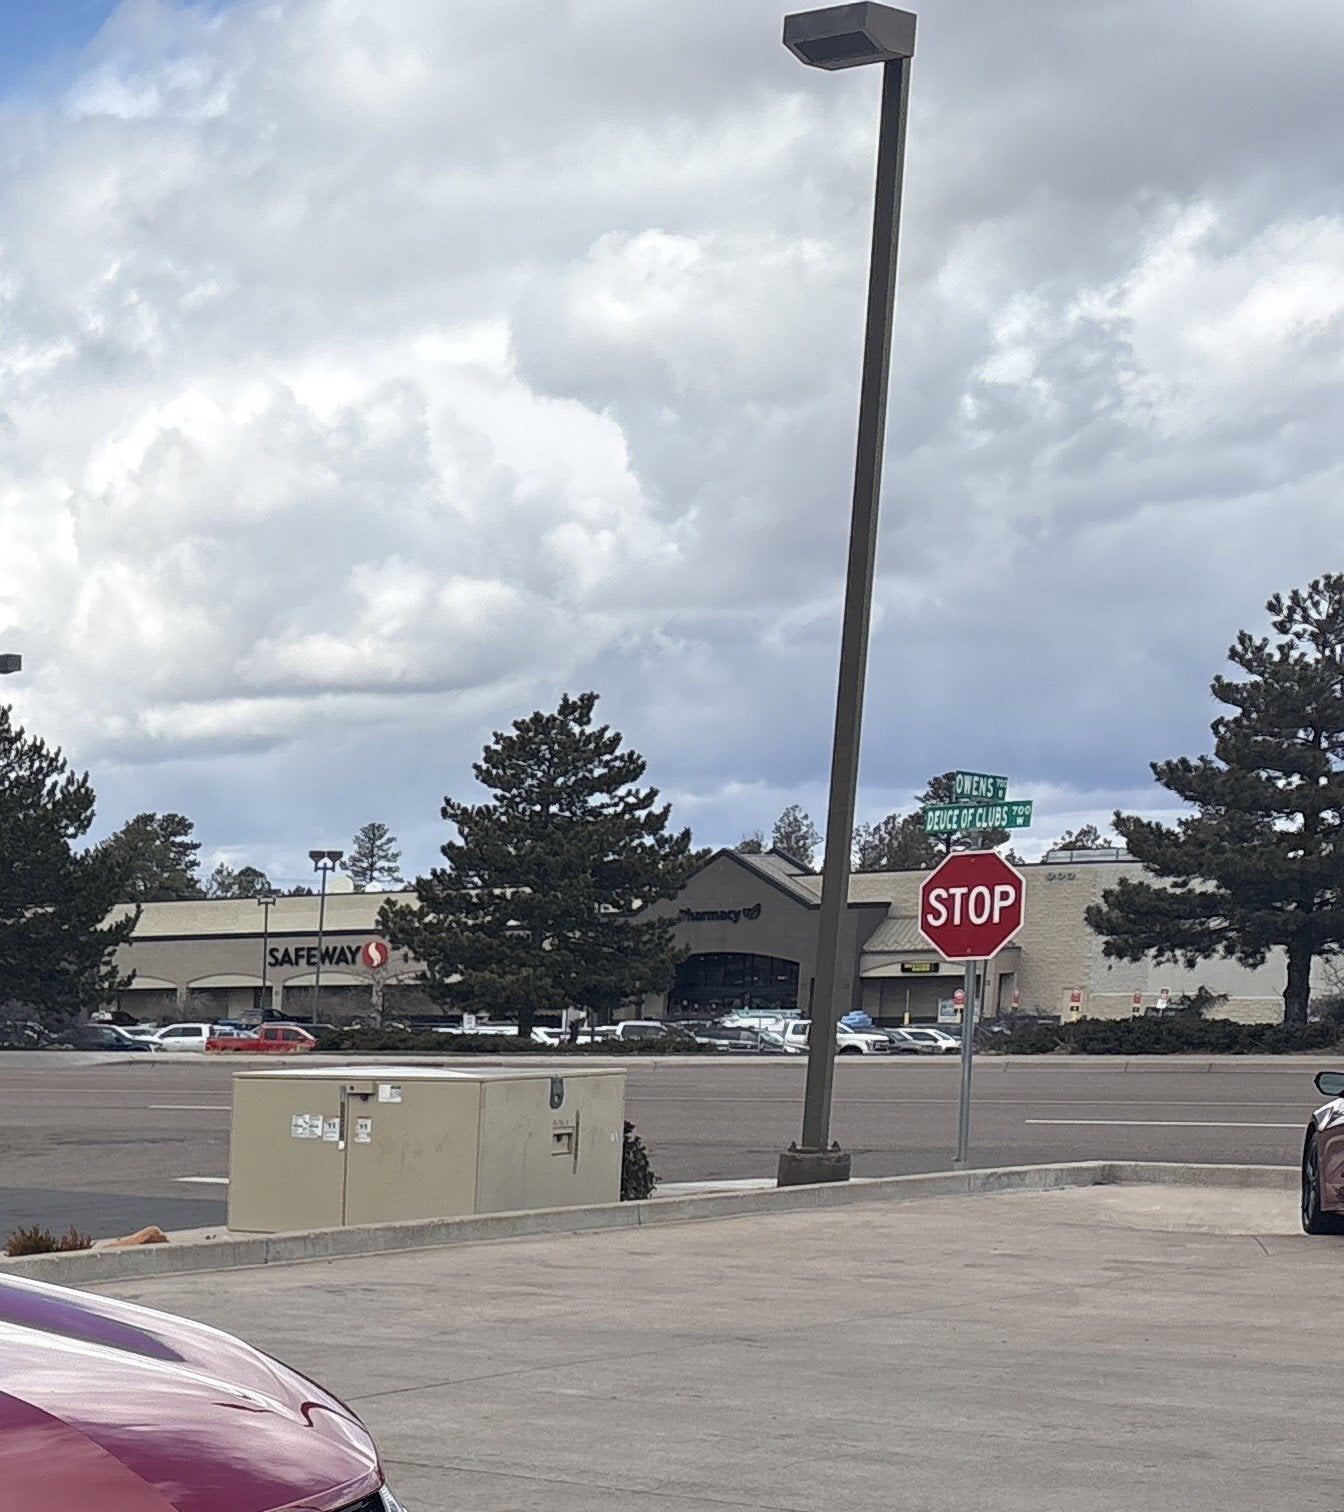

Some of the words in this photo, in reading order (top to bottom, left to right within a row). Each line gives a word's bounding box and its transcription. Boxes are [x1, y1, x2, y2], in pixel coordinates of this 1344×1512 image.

[955, 773, 994, 797] OWENS
[926, 808, 960, 831] DEUCE
[960, 808, 975, 829] OF
[975, 805, 1009, 828] CLUBS
[1011, 804, 1031, 816] 700
[926, 884, 1016, 927] STOP
[267, 945, 362, 967] SAFEWAY
